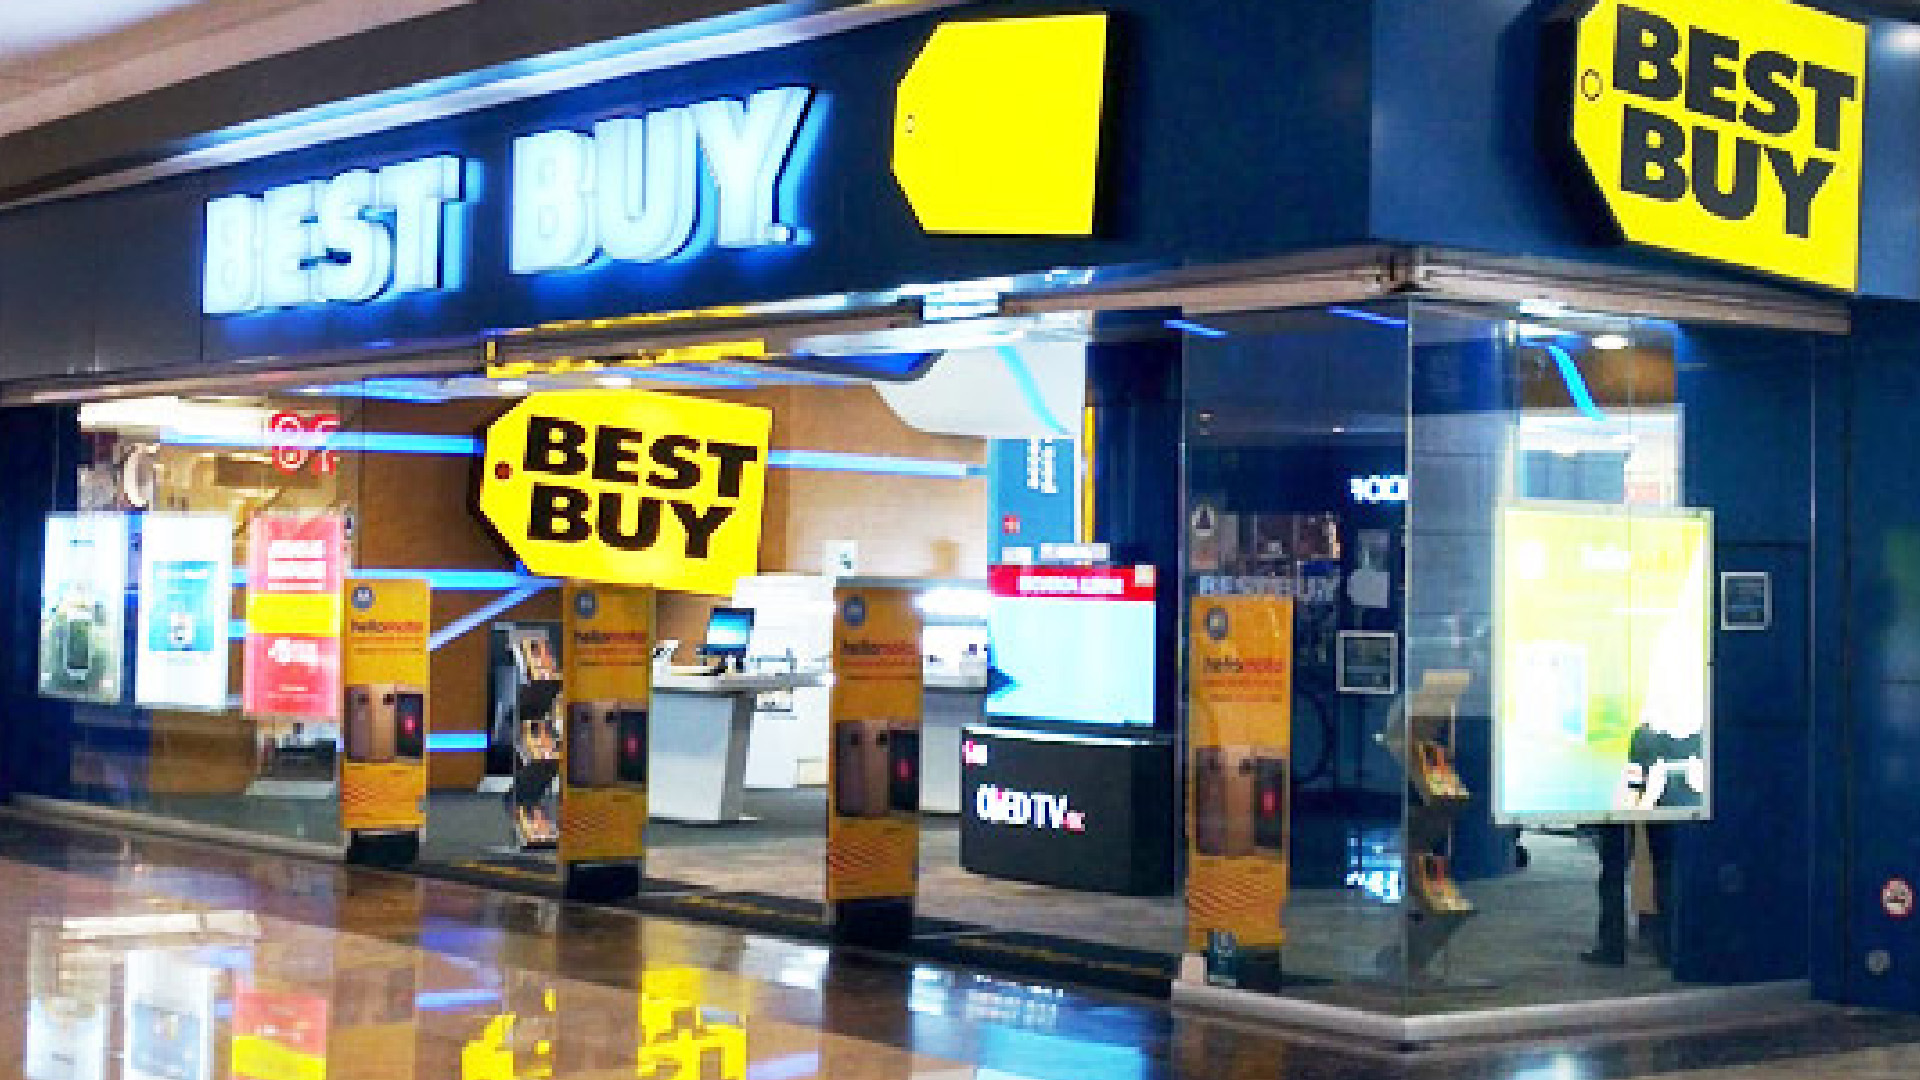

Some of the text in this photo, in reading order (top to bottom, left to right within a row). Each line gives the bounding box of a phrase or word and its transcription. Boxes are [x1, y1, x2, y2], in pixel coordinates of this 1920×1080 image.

[1612, 3, 1859, 152] BEST
[203, 154, 468, 314] BEST
[1620, 104, 1836, 238] BUY
[523, 414, 758, 497] BEST
[527, 482, 736, 558] BUY
